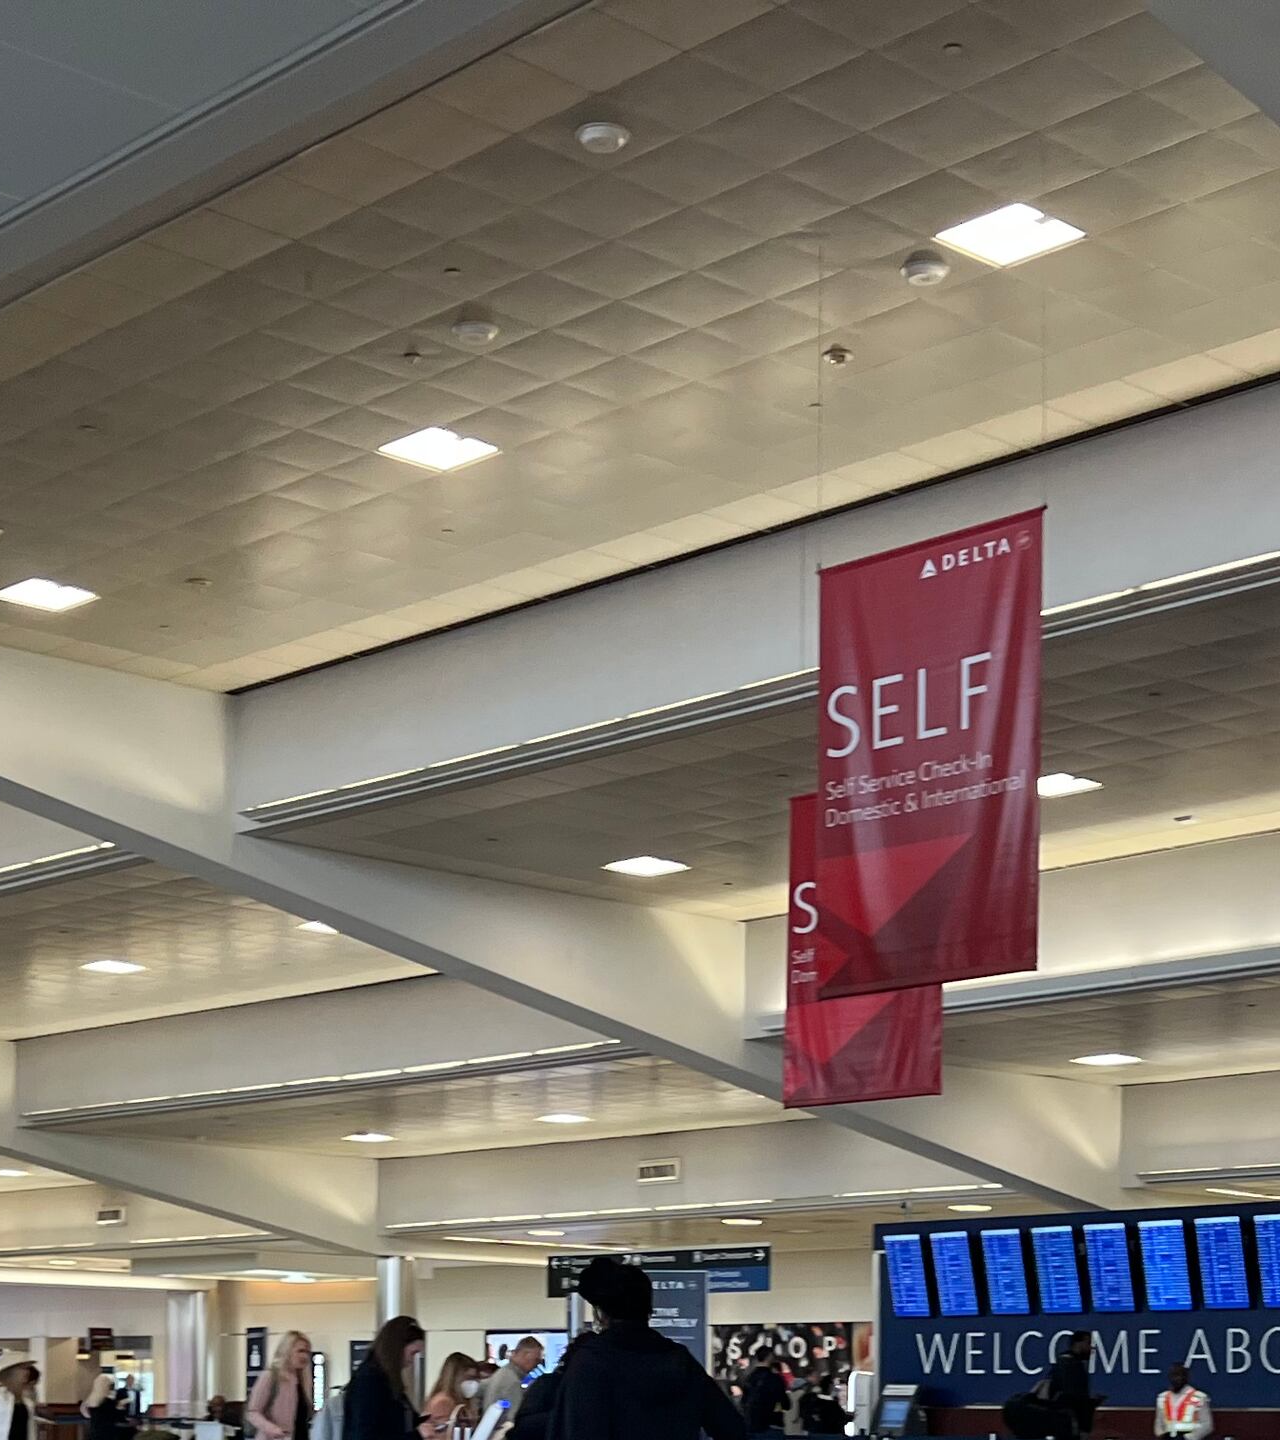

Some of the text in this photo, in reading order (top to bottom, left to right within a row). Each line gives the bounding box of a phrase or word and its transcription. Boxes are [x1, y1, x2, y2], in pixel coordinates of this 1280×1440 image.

[942, 537, 1011, 571] DELTA
[826, 651, 992, 758] SELF
[858, 769, 916, 795] Service
[918, 751, 993, 781] Check-In
[825, 769, 1027, 827] Domestic & International
[651, 1280, 686, 1290] ELTA
